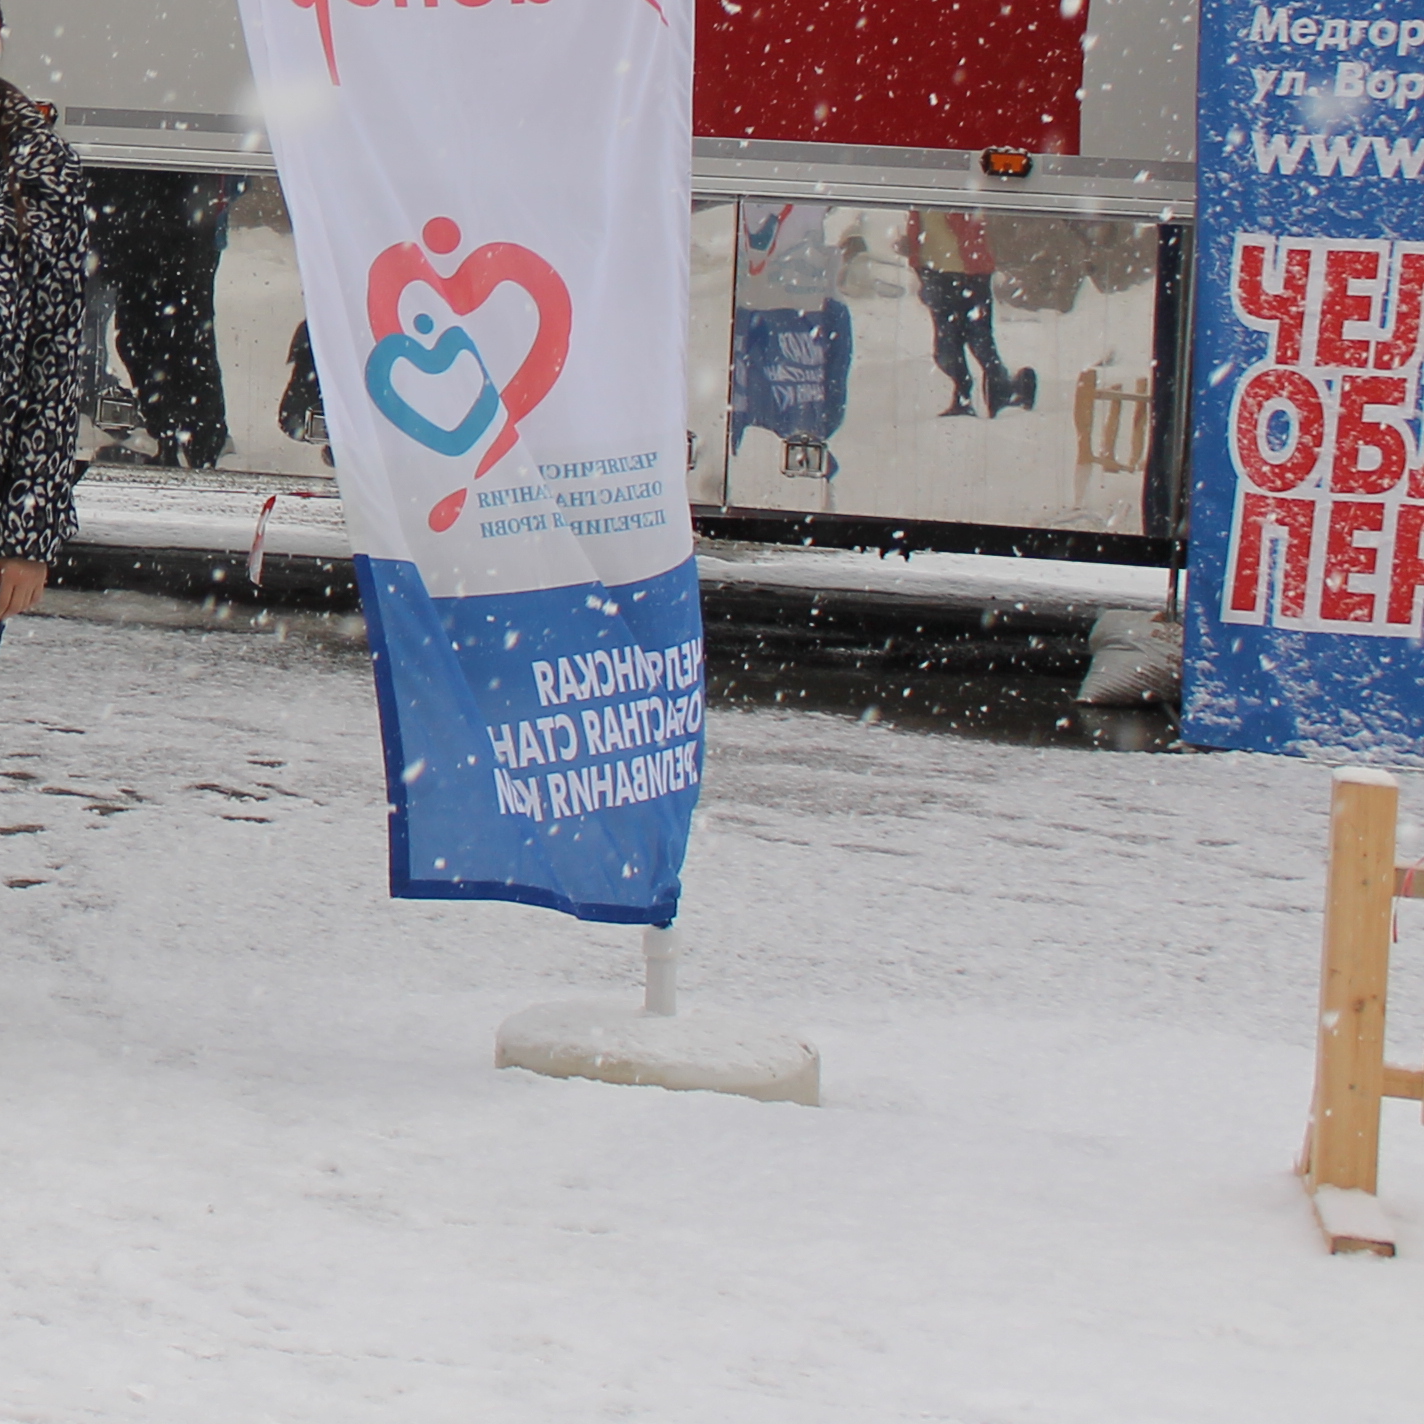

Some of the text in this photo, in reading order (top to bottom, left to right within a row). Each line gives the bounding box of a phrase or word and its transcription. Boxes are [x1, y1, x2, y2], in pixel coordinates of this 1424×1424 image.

[1250, 4, 1424, 57] Медгор
[1334, 62, 1424, 110] Вор
[1235, 368, 1424, 495] ОБ
